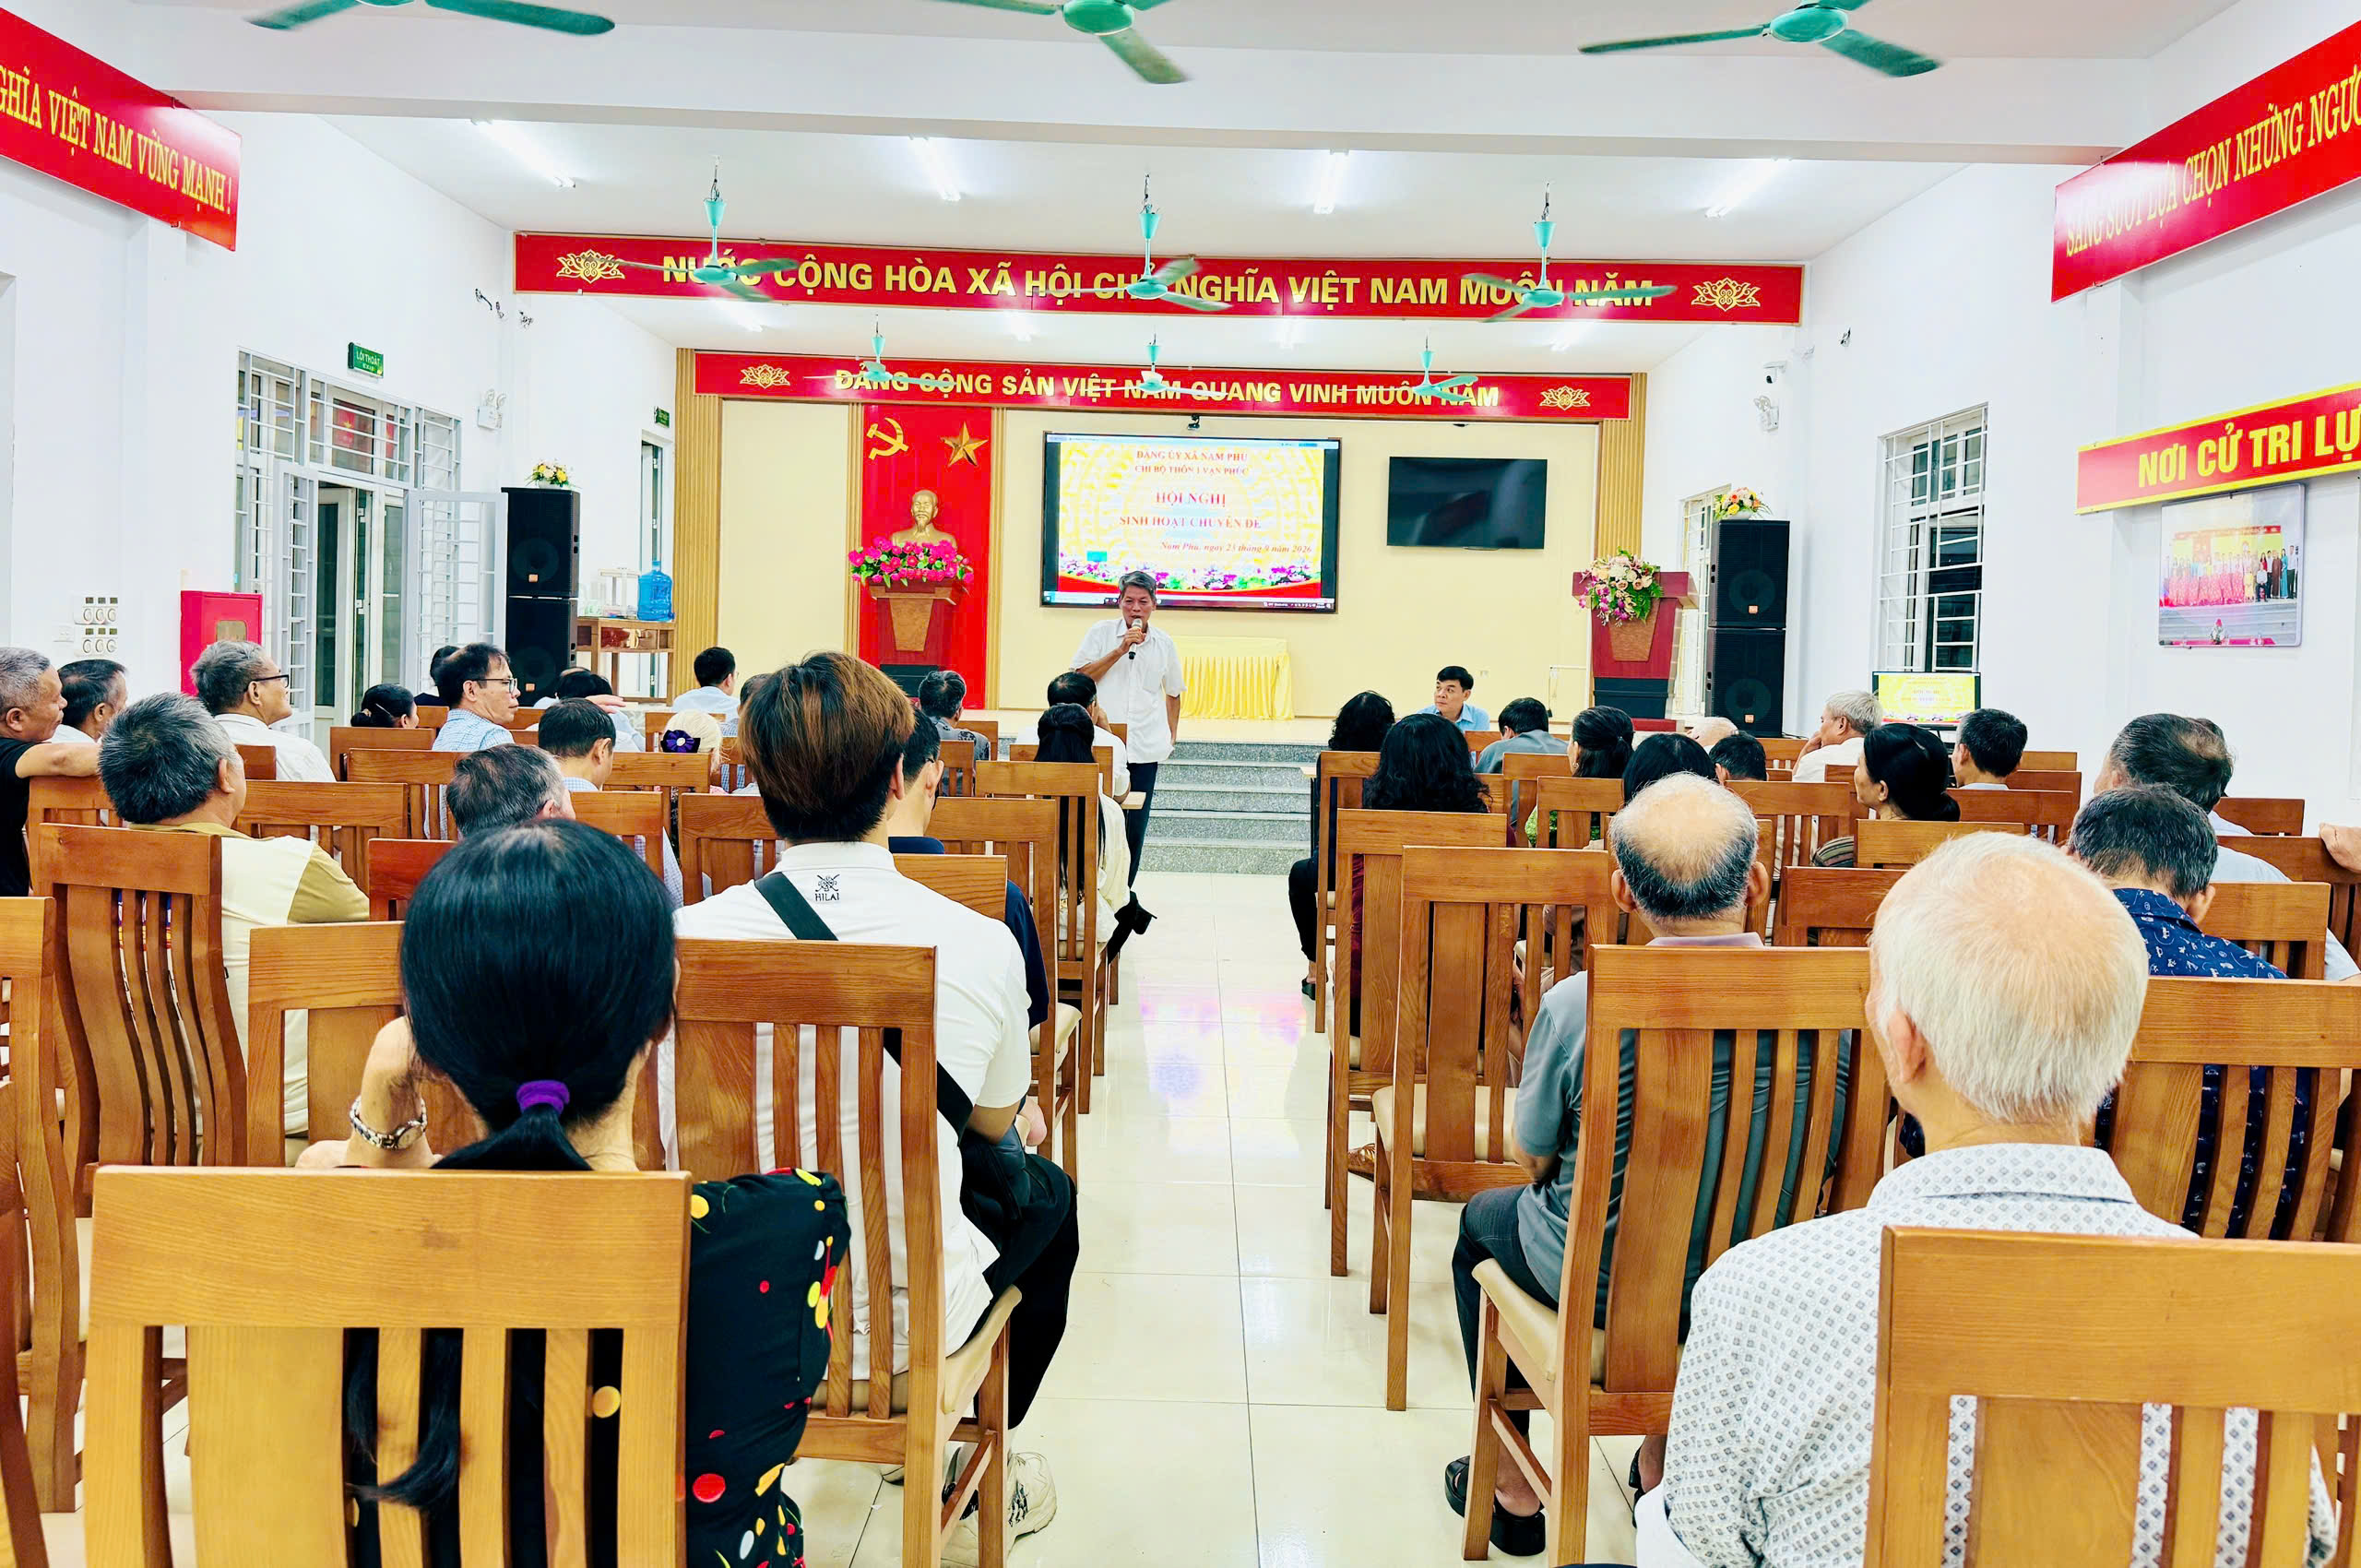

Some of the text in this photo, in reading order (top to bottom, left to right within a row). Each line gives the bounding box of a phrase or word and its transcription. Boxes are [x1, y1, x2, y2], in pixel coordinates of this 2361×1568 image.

[48, 86, 90, 156] VIỆT
[93, 113, 133, 170] NAM
[137, 128, 179, 190] VỮNG
[182, 155, 226, 212] MẠNH
[2182, 138, 2231, 208] CHỌN
[2234, 102, 2304, 183] NHỮNG
[773, 254, 872, 295] CỘNG
[884, 257, 957, 293] HÒA
[966, 261, 1017, 296] XÃ
[1025, 263, 1082, 305] HỘI
[1093, 262, 1158, 300] CH
[1175, 267, 1280, 303] NGHĨA
[1287, 269, 1360, 311] VIỆT
[1370, 278, 1448, 304] NAM
[1573, 271, 1653, 306] NĂM
[919, 368, 992, 398] CỘNG
[1002, 368, 1055, 397] SẢN
[1062, 373, 1117, 402] VIỆT
[1191, 381, 1282, 403] QUANG
[1288, 383, 1347, 404] VINH
[1154, 465, 1167, 475] BỘ
[1169, 465, 1194, 473] THÔN
[1201, 452, 1225, 461] NAM
[2138, 443, 2188, 488] NƠI
[2197, 422, 2244, 478] CỬ
[2248, 420, 2303, 469] TRI
[1156, 491, 1226, 508] HỘI NGHỊ
[1120, 516, 1148, 526] SINH
[1152, 516, 1186, 529] HOẠT
[1190, 516, 1241, 528] CHUYÊN
